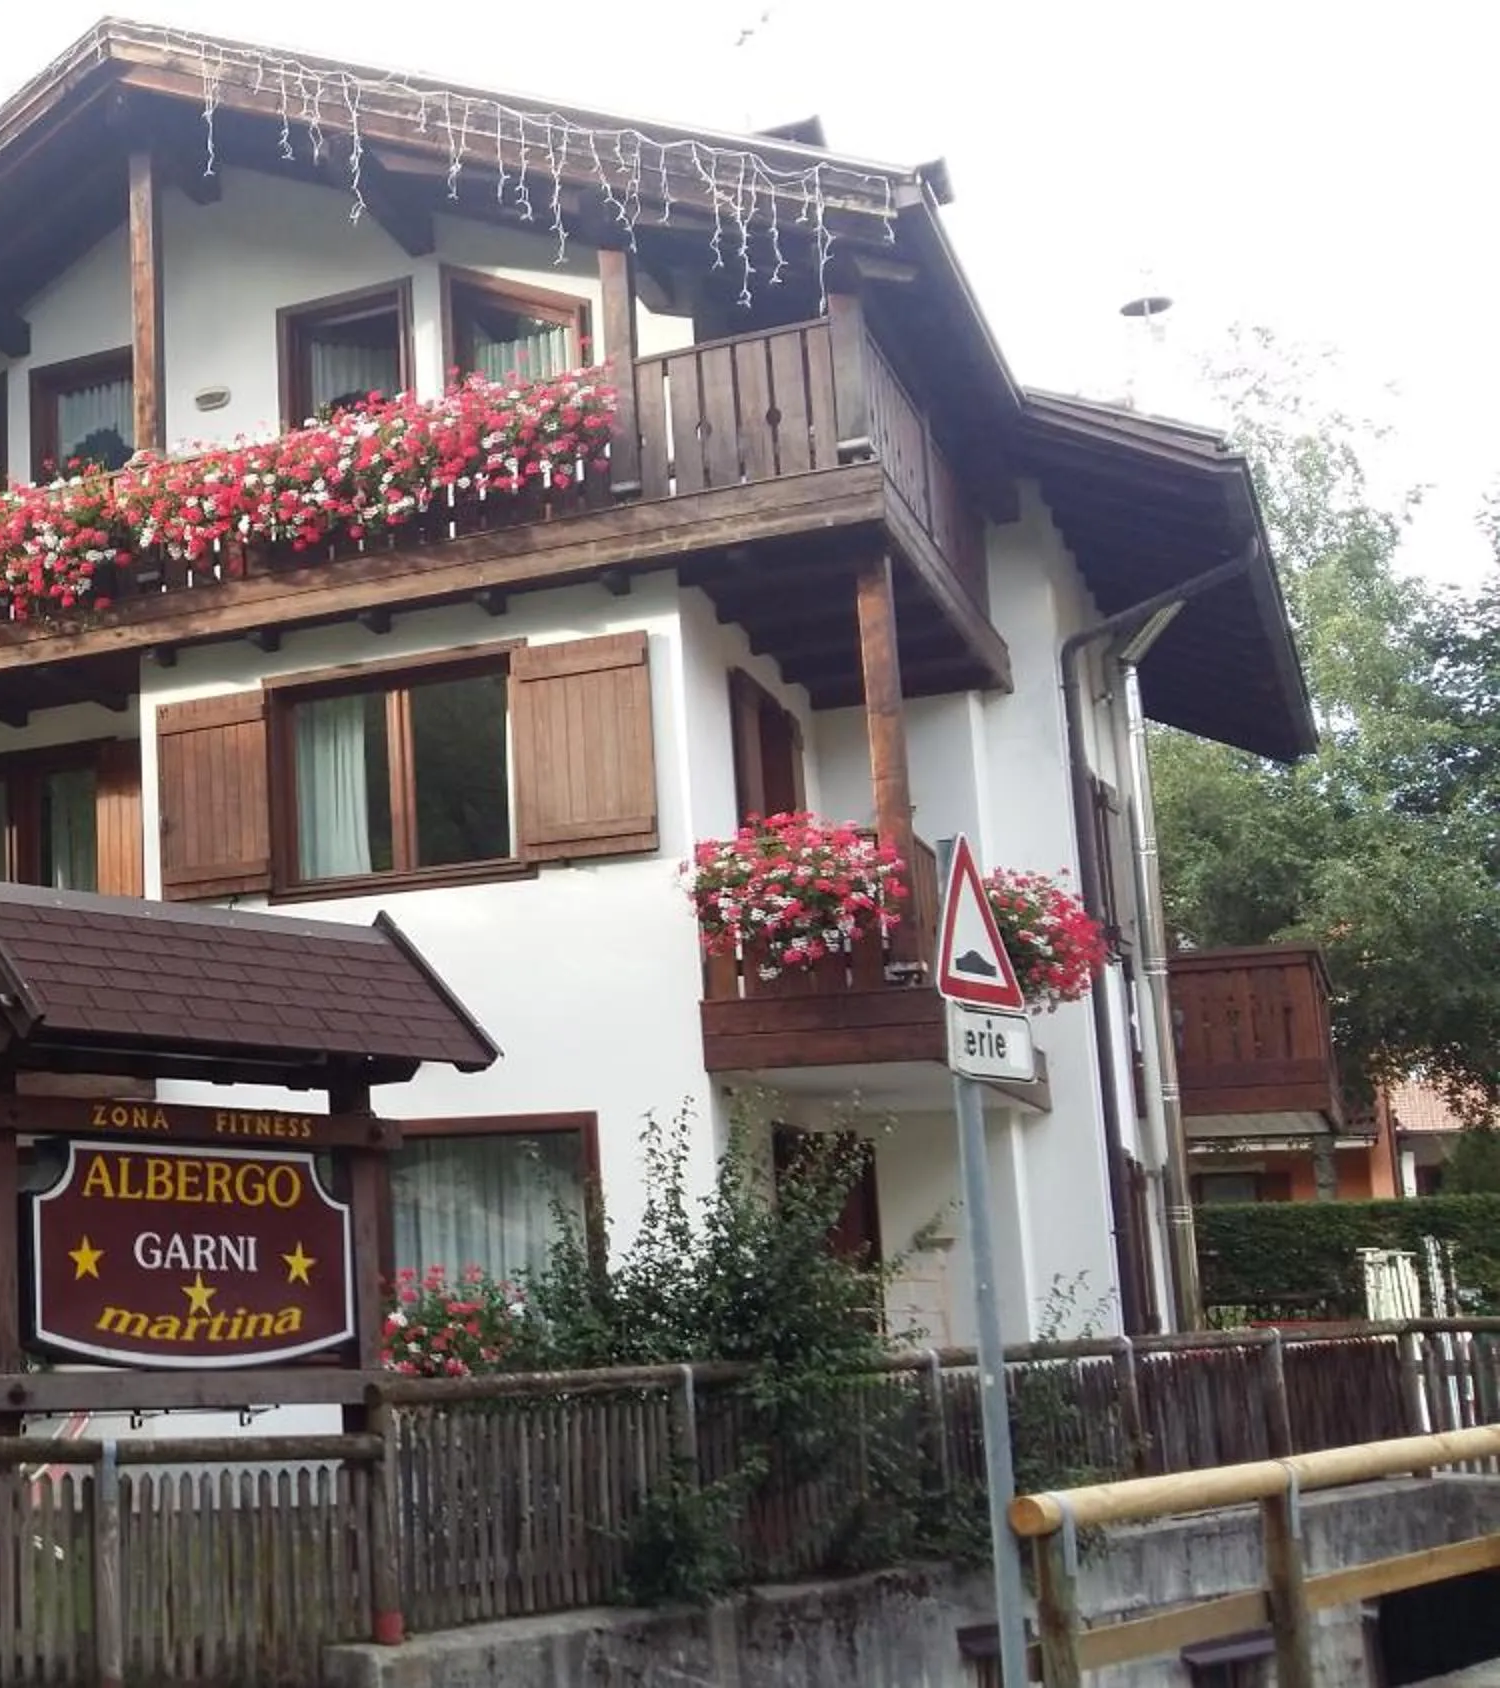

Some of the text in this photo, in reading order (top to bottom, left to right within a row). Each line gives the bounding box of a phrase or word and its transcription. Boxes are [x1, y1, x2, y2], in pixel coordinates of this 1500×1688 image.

[93, 1104, 312, 1138] ZONA FITNESS
[83, 1153, 301, 1208] ALBERGO
[133, 1231, 258, 1272] GARNI
[95, 1306, 302, 1341] martina
